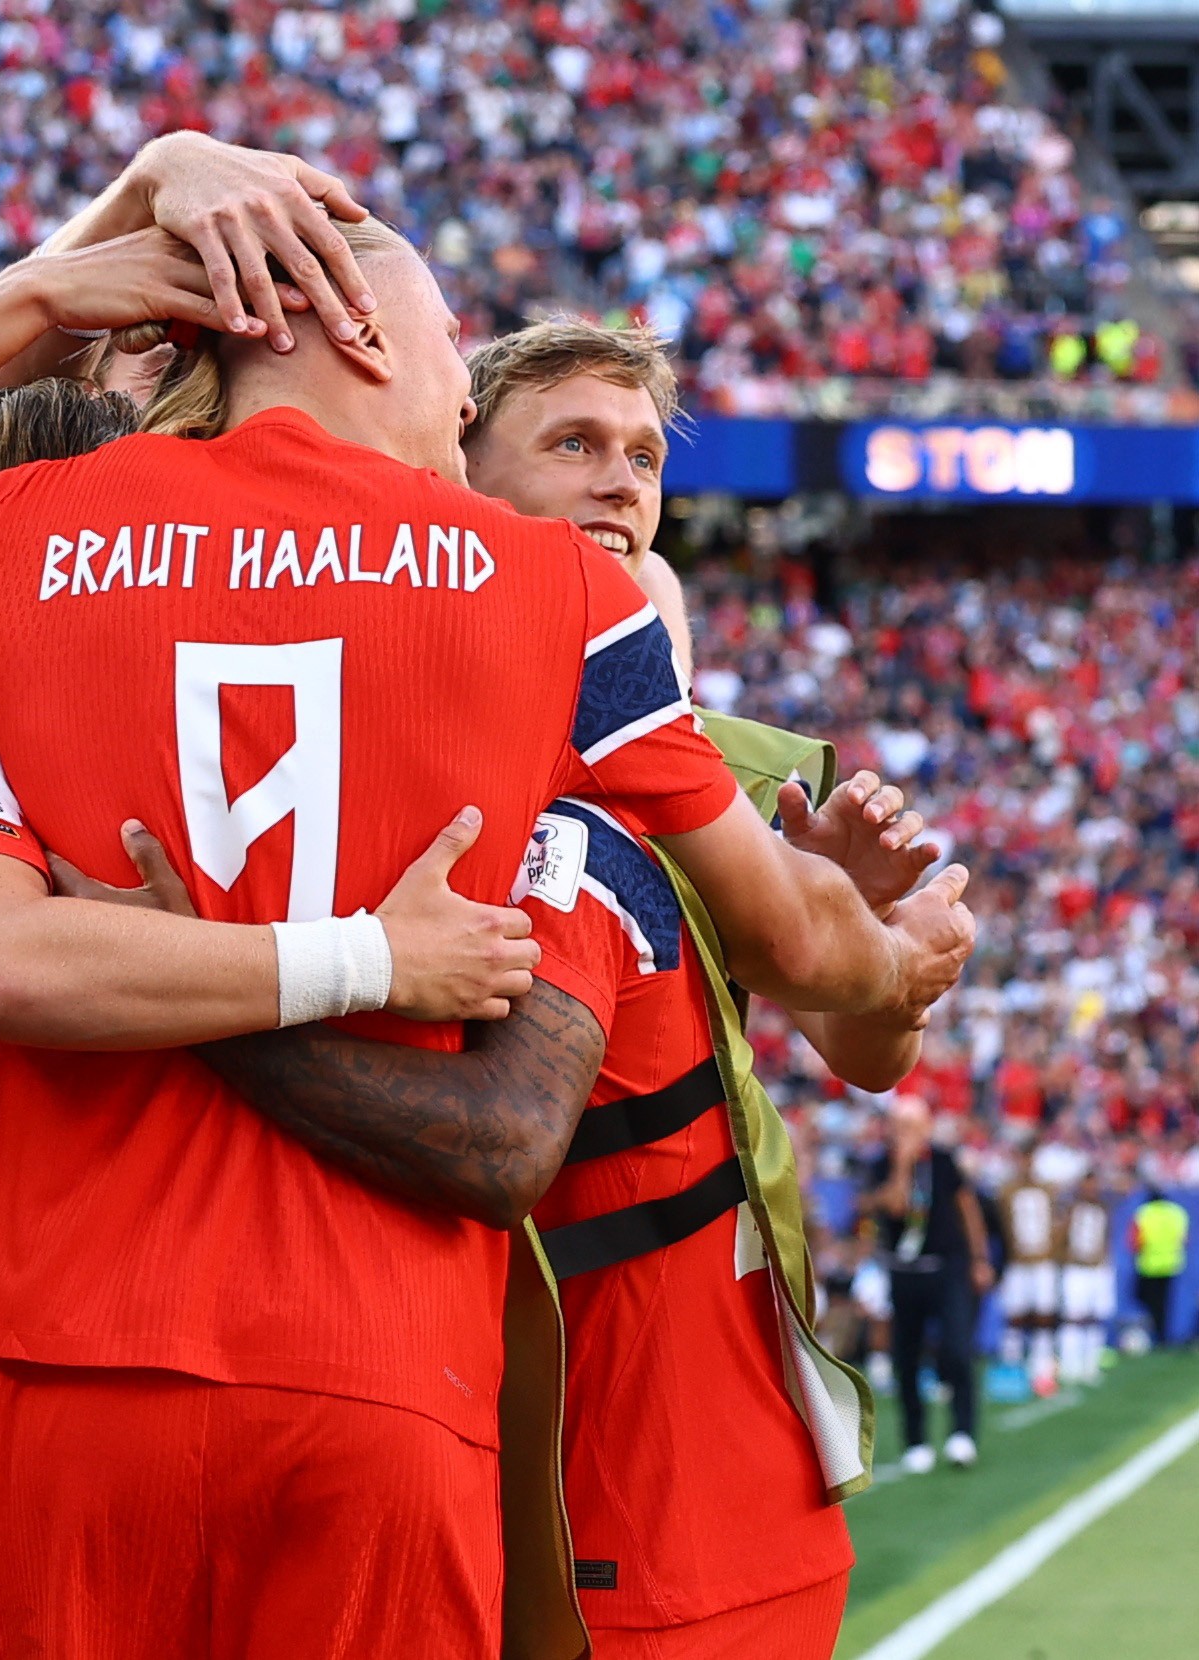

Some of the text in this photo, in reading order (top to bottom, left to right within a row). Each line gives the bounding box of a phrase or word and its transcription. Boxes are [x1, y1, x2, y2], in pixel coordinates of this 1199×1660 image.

[39, 523, 495, 601] BRAUT HAALAND
[175, 637, 344, 922] 9
